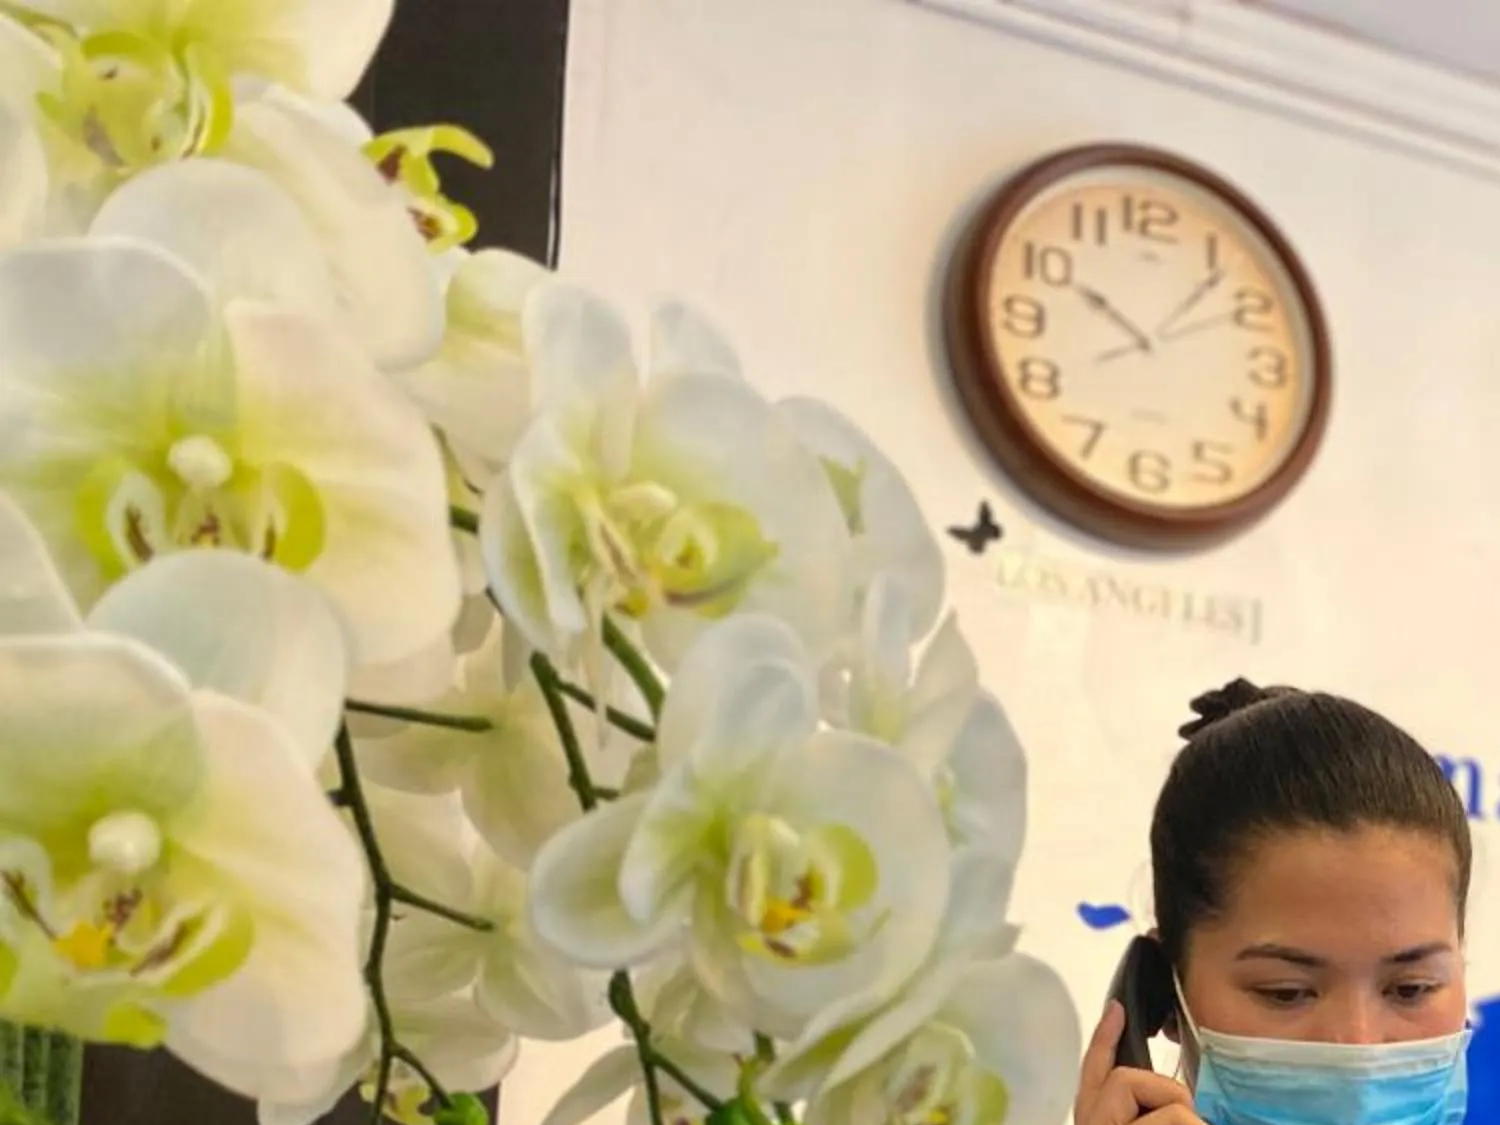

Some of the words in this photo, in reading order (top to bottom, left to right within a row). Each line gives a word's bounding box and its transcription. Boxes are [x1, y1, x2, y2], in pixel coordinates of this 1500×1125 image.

[1072, 203, 1106, 245] 11
[1122, 195, 1180, 243] 12
[1024, 242, 1073, 287] 10
[1205, 232, 1219, 271] 1
[1001, 295, 1045, 339] 9
[1233, 288, 1275, 331] 2
[1018, 357, 1060, 400] 8
[1248, 348, 1288, 389] 3
[1062, 414, 1107, 459] 7
[1231, 397, 1268, 441] 4
[1128, 450, 1170, 493] 6
[1193, 442, 1233, 485] 5
